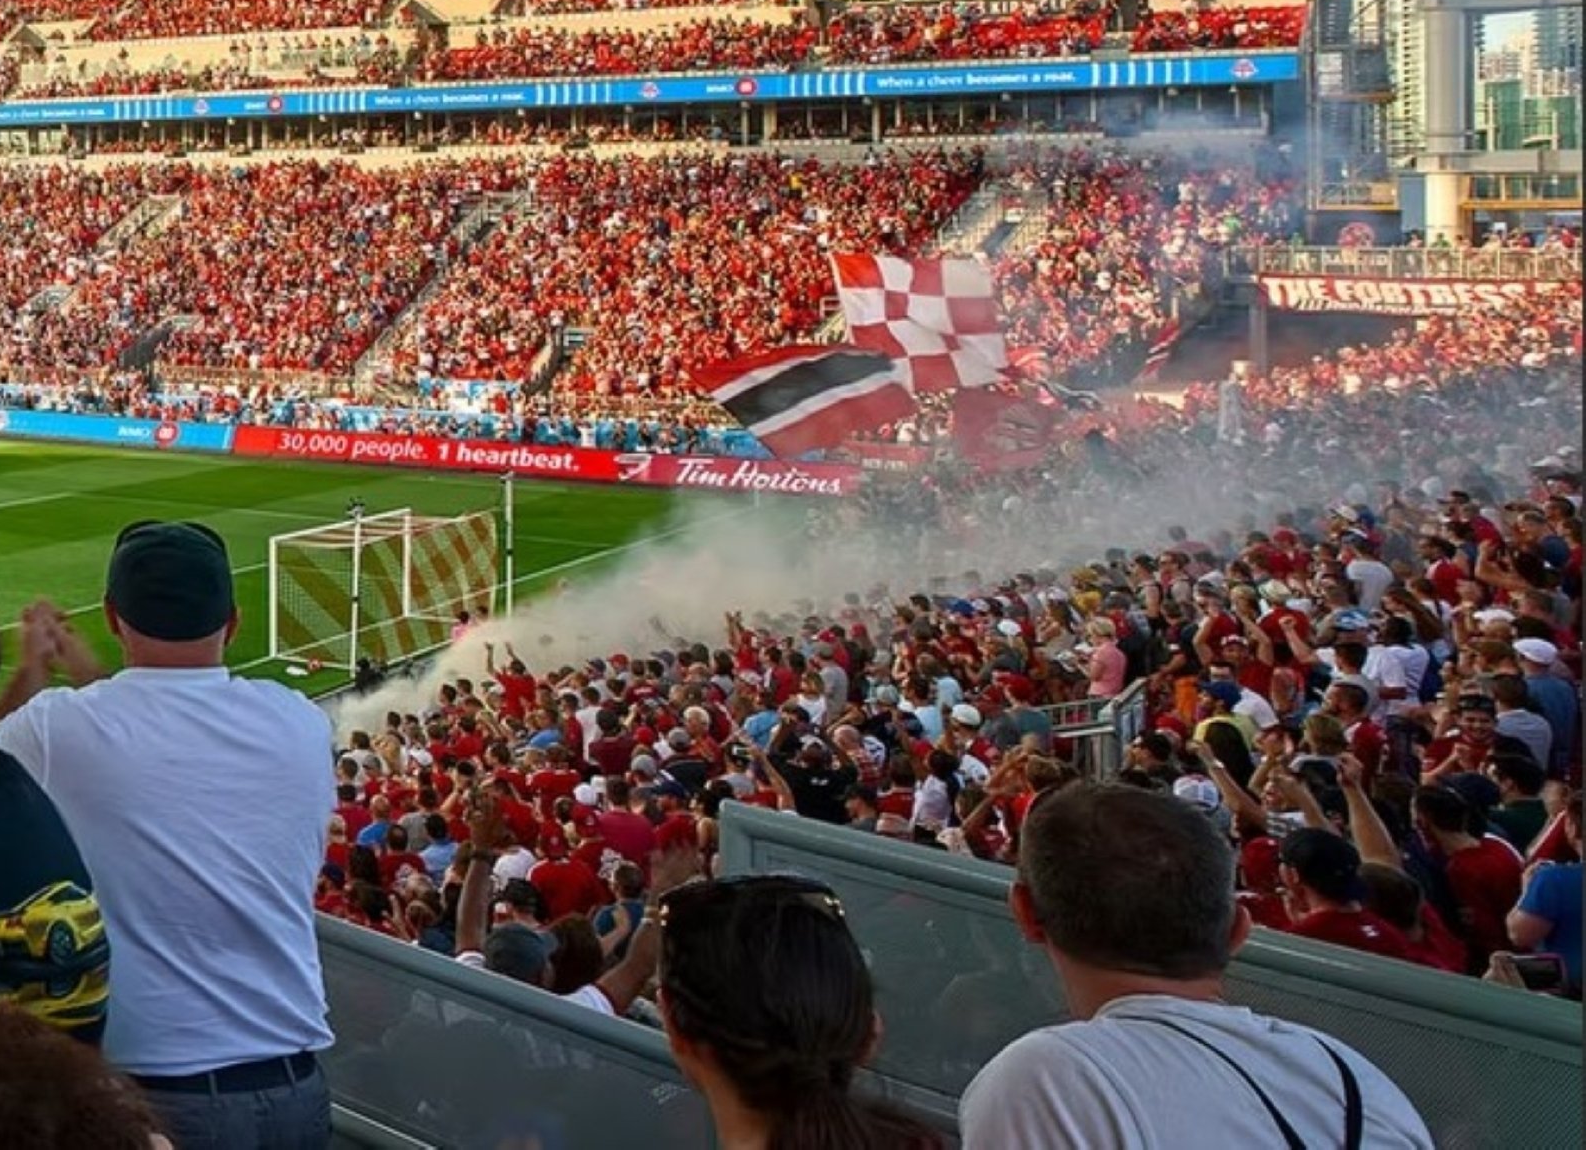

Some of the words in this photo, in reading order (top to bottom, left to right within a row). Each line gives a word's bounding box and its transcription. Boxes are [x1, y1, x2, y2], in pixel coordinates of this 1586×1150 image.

[877, 75, 913, 89] When
[916, 78, 925, 88] a
[927, 75, 963, 88] cheer
[966, 73, 1028, 86] becomes
[1031, 73, 1041, 83] a
[1262, 276, 1329, 309] THE
[1334, 279, 1527, 311] FORTRESS
[278, 433, 345, 455] 30,000
[351, 437, 428, 461] people.
[437, 443, 449, 460] 1
[456, 444, 580, 471] heartbeat.
[675, 456, 729, 487] Tim
[728, 459, 841, 494] Hortons
